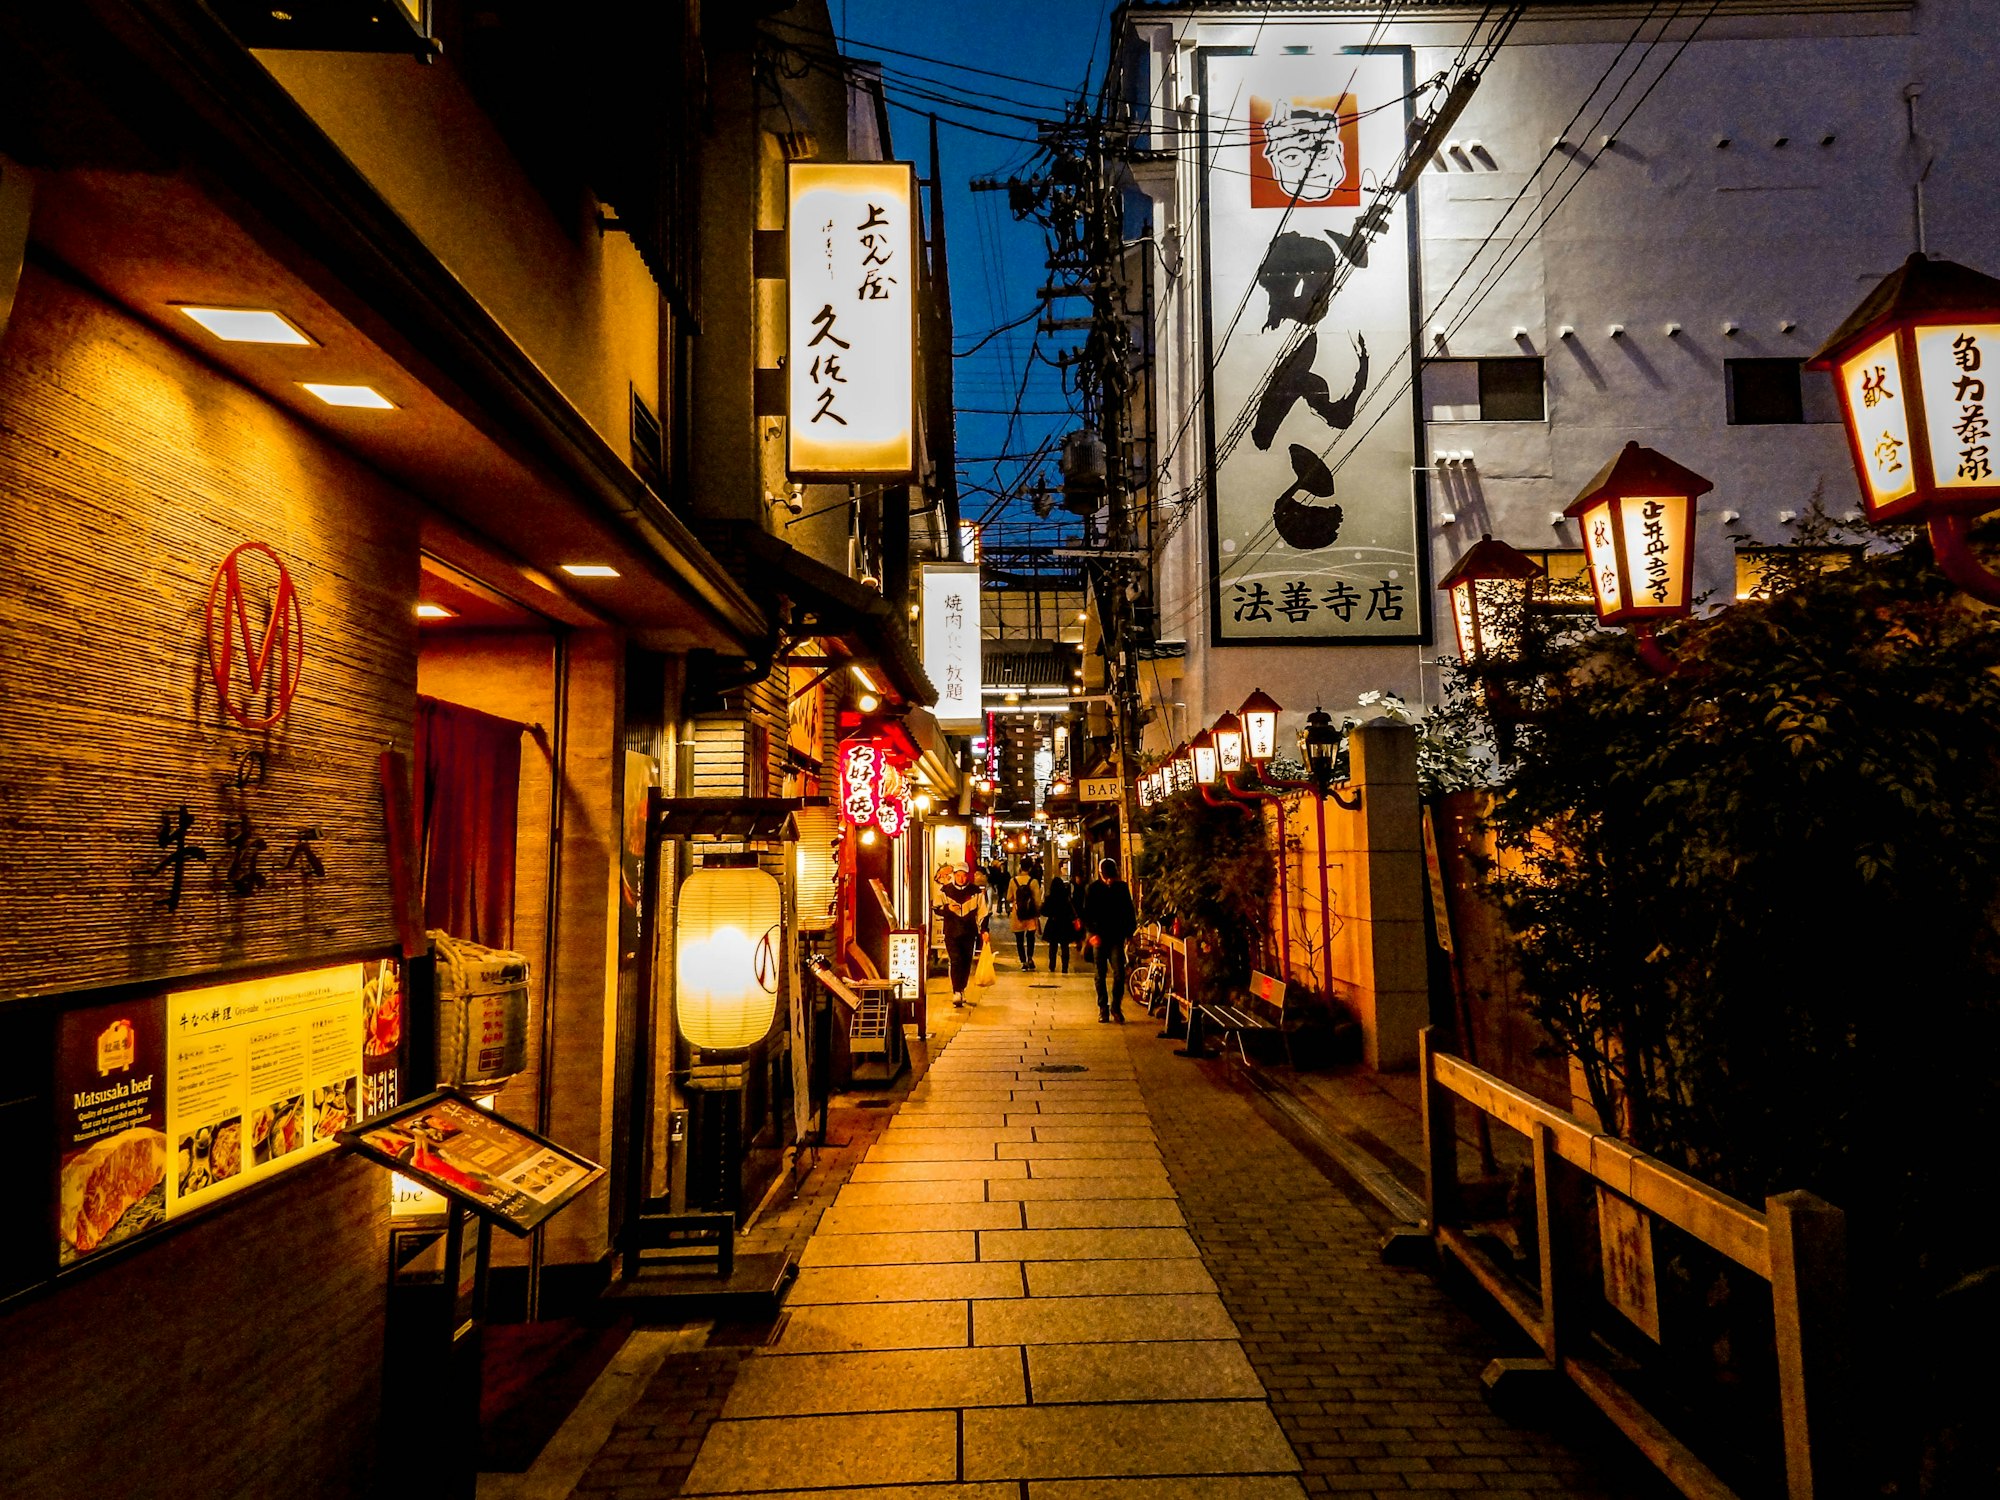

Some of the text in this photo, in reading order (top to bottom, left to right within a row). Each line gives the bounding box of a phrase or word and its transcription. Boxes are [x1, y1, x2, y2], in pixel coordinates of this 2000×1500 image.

[1232, 580, 1405, 623] 法善寺店
[1087, 783, 1118, 796] BAR
[73, 1074, 154, 1110] Matsusaka beef
